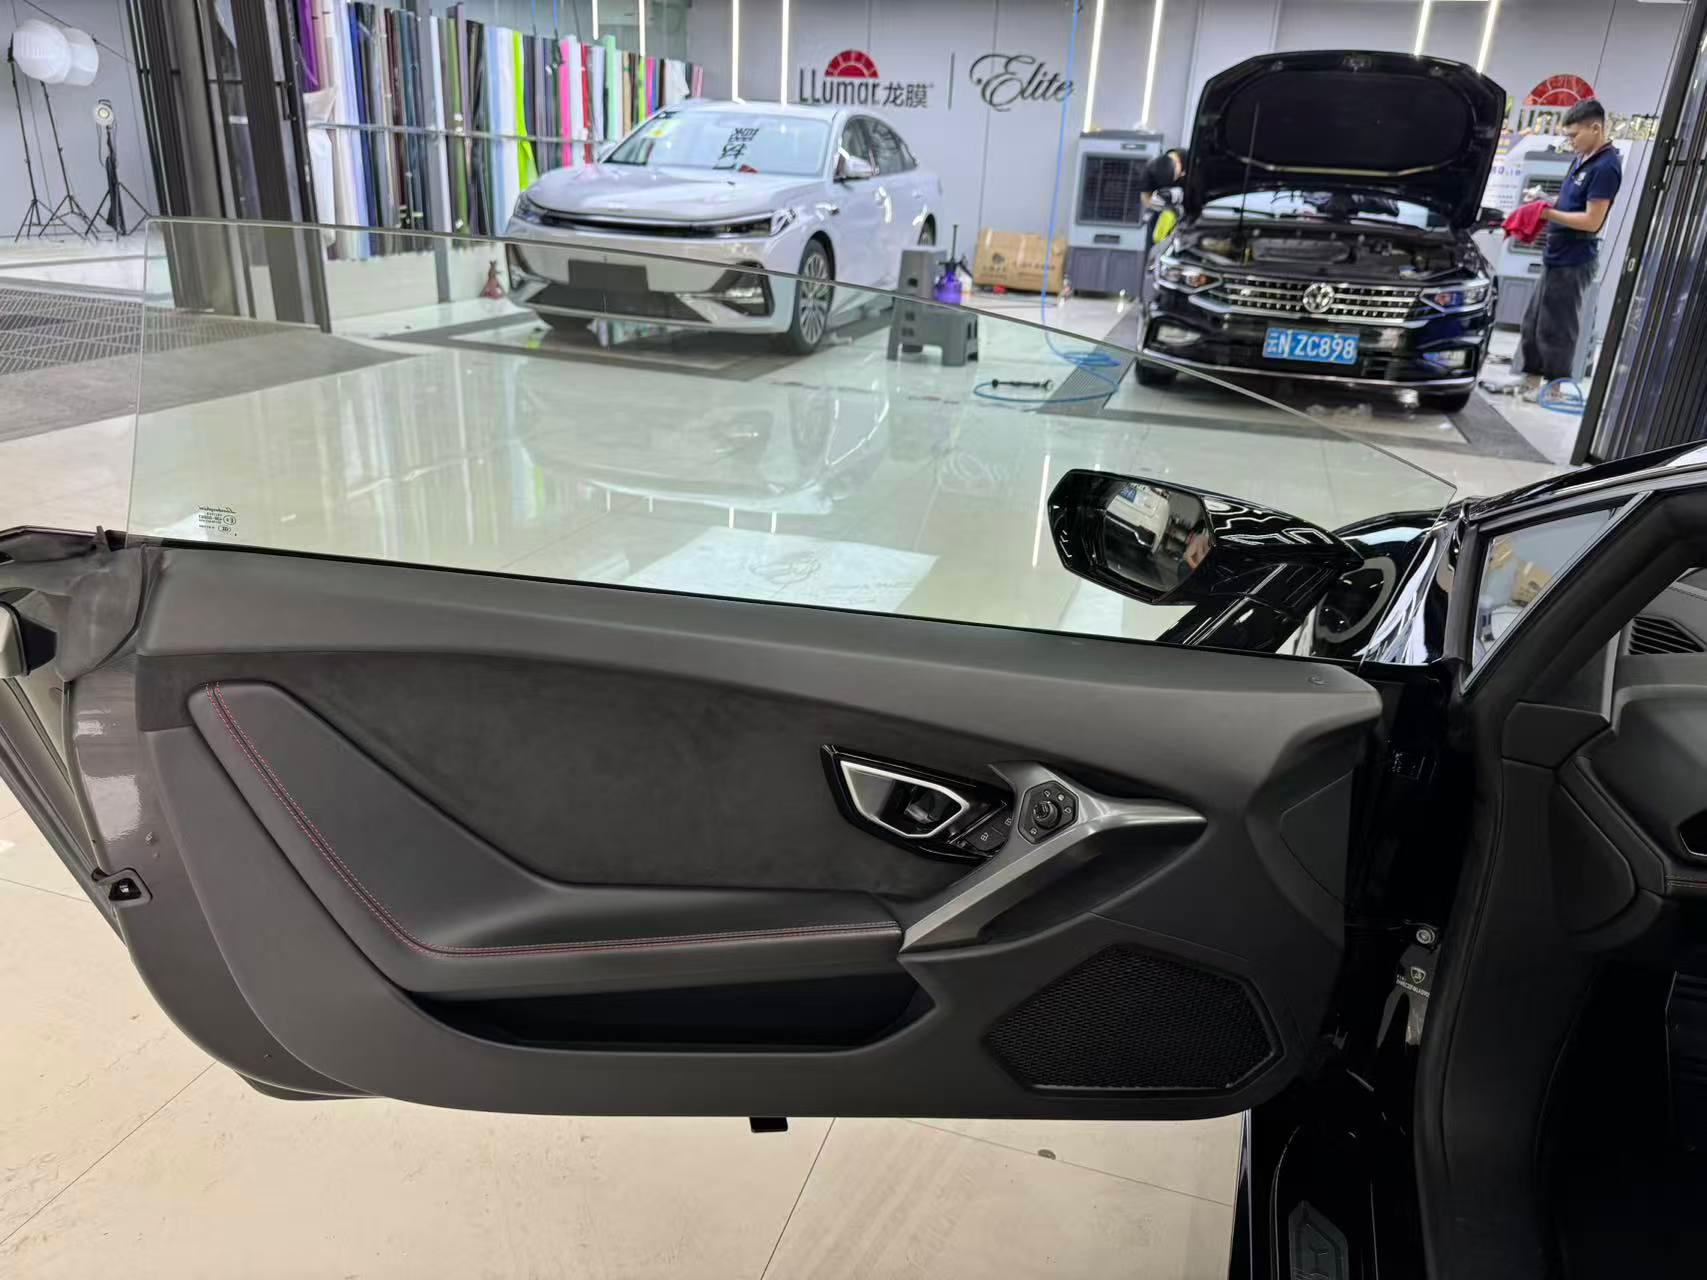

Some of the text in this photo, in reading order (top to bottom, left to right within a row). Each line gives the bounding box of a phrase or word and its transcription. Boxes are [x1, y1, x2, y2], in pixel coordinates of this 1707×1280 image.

[799, 68, 880, 105] LLumar
[883, 82, 929, 108] 龙膜
[969, 53, 1075, 112] Elite
